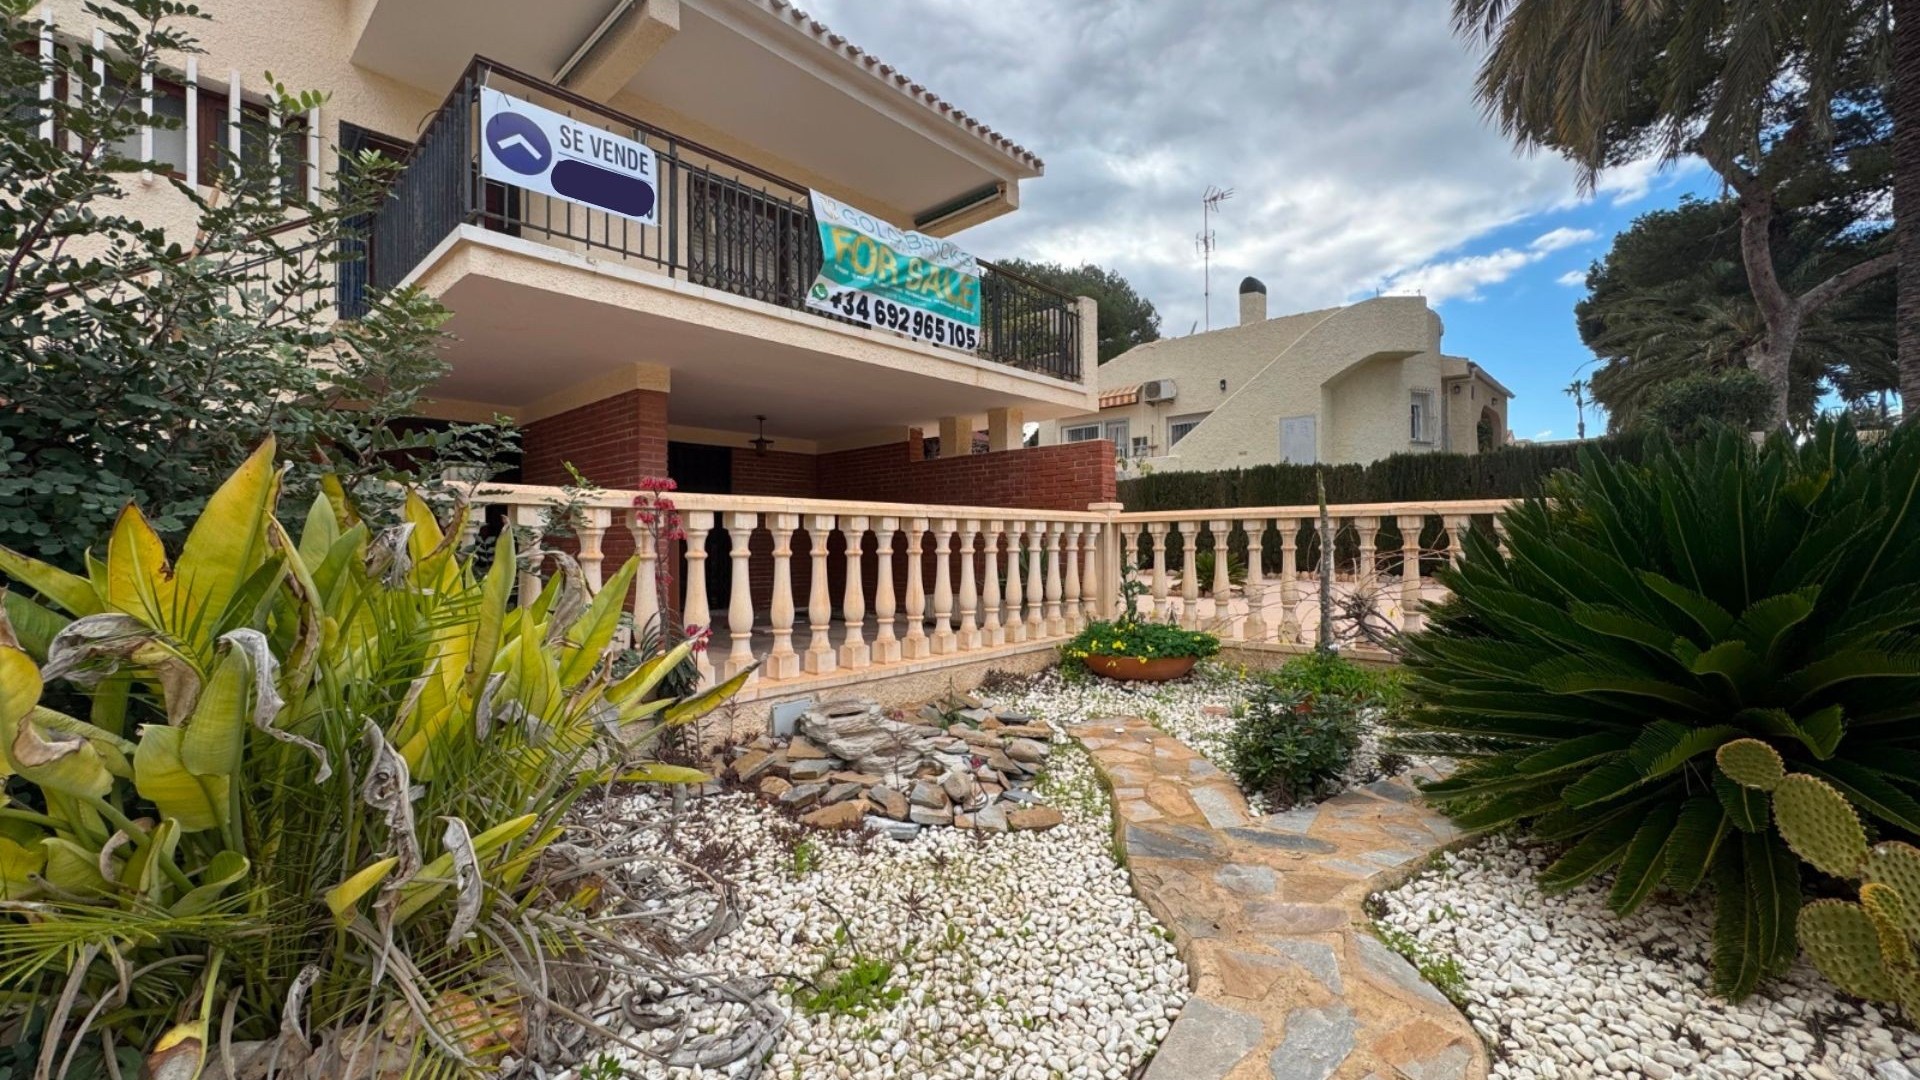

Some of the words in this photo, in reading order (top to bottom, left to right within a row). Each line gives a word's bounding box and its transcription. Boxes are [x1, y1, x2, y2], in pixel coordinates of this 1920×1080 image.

[560, 124, 584, 154] SE
[589, 134, 649, 175] VENDE
[831, 227, 898, 285] FOR
[906, 257, 975, 309] SALE
[830, 291, 870, 321] +34
[874, 299, 910, 332] 692
[913, 310, 945, 343] 965
[948, 321, 976, 350] 105
